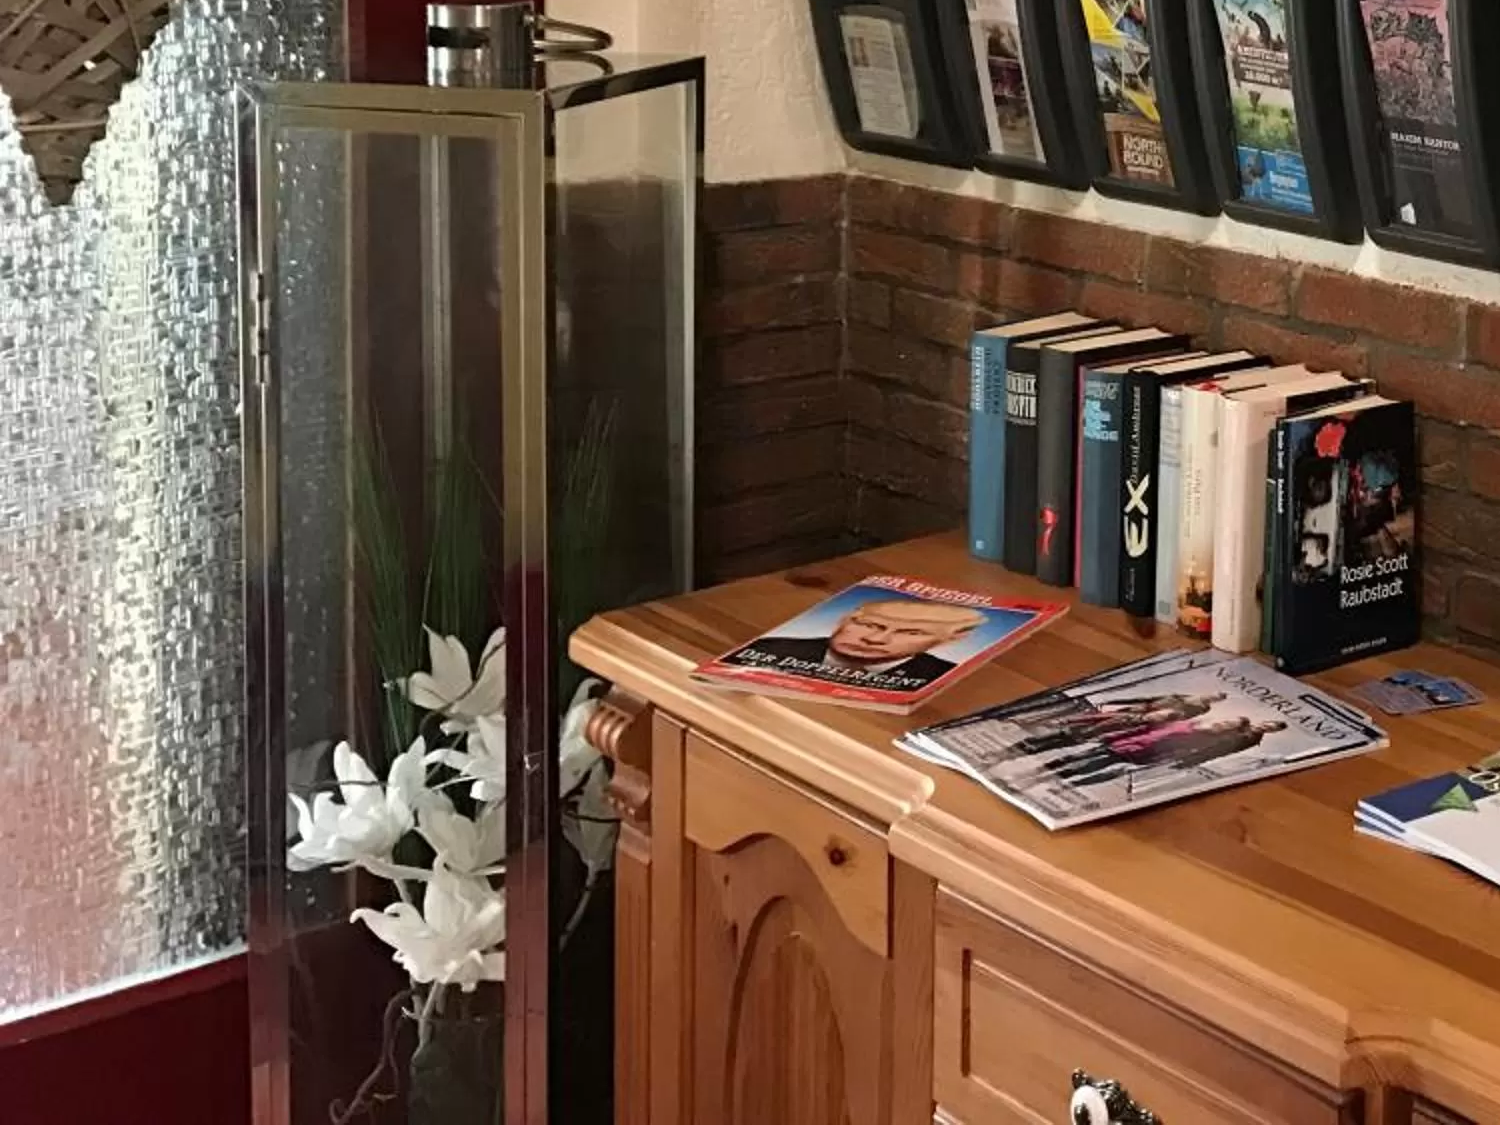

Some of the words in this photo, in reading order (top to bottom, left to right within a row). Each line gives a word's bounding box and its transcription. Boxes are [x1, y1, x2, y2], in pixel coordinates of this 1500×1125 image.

[1123, 133, 1166, 154] NORTH
[1123, 150, 1164, 169] BOUND
[1340, 562, 1374, 584] Rosie
[1375, 553, 1409, 576] Scott
[862, 574, 907, 593] DER
[907, 582, 993, 607] SPIEGEL
[1340, 577, 1404, 609] Raubstadt
[736, 648, 780, 665] DER
[779, 655, 928, 690] DOPPELREGENT
[1214, 666, 1348, 741] NORDERLAND
